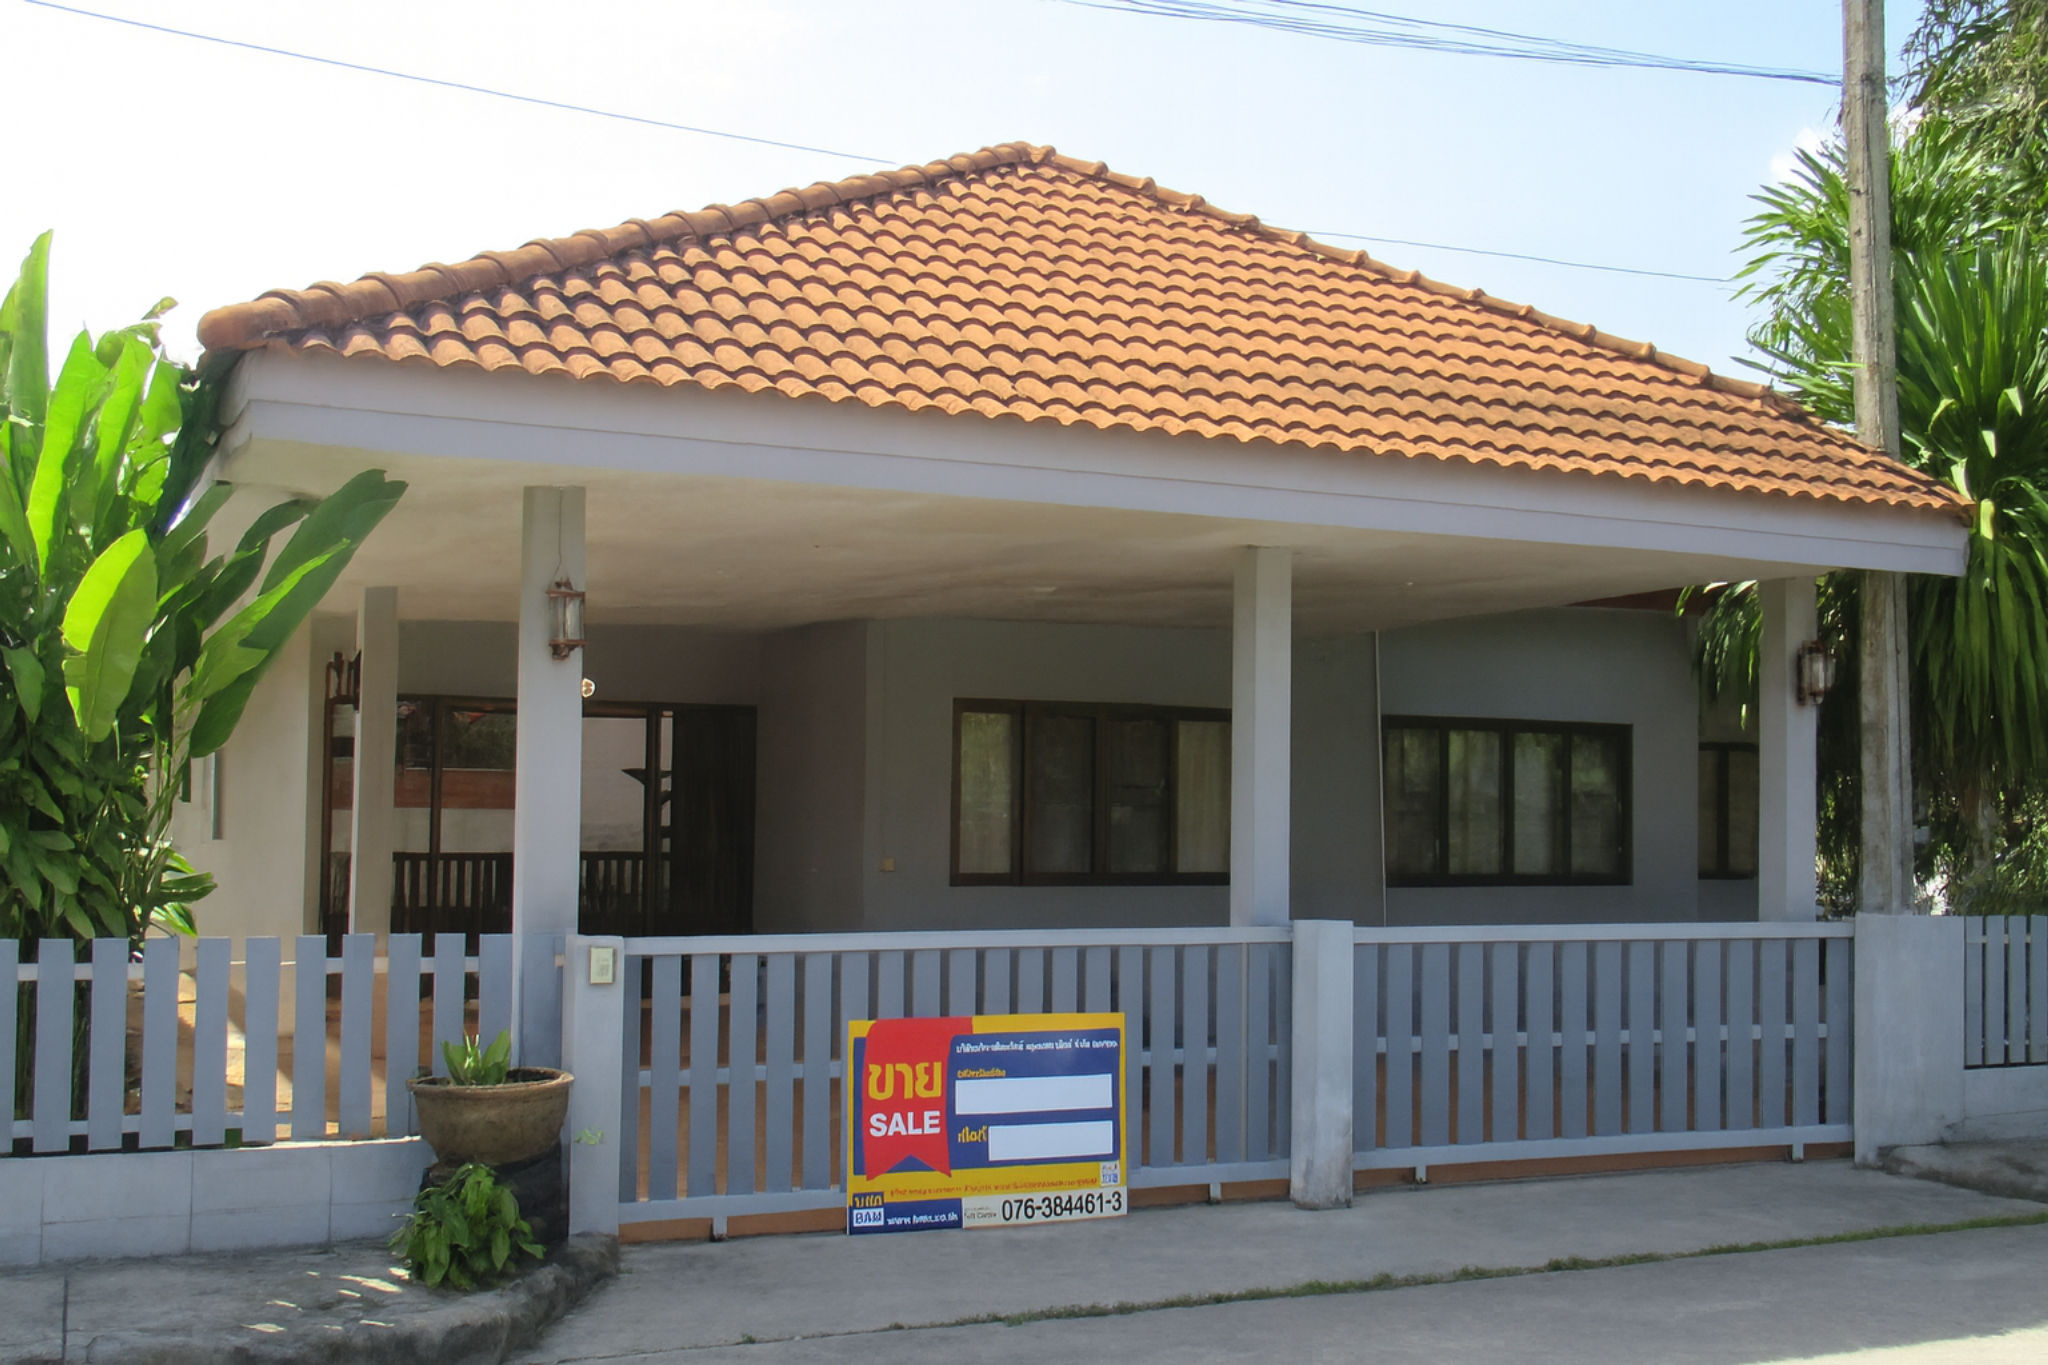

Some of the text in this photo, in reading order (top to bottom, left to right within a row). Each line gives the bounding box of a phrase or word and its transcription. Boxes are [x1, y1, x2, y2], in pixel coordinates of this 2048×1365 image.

[868, 1061, 942, 1101] ขาย
[869, 1110, 941, 1137] SALE
[1002, 1190, 1122, 1222] 076-384461-3
